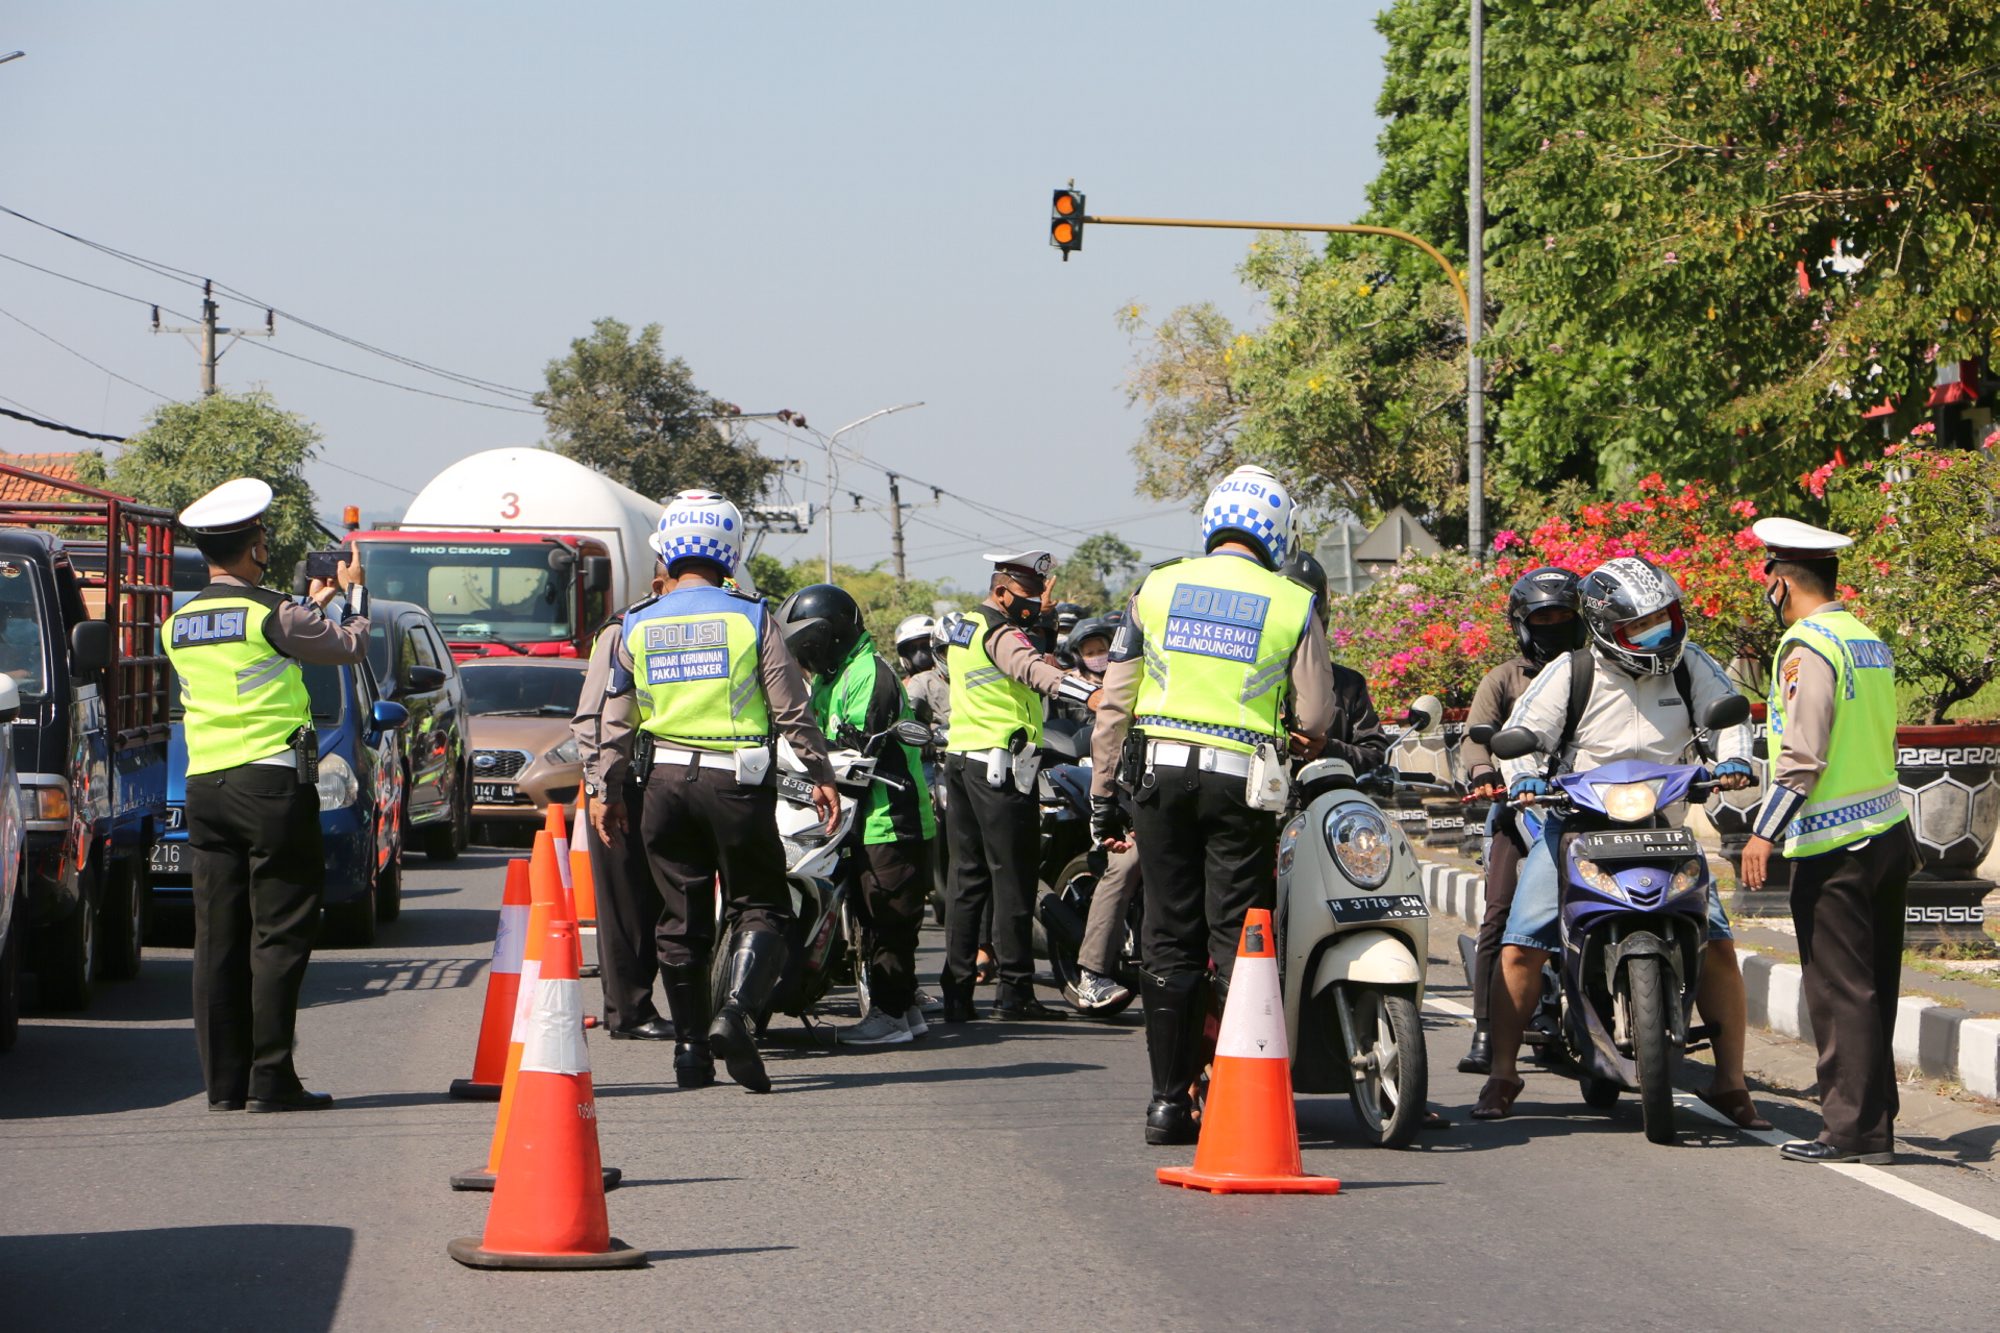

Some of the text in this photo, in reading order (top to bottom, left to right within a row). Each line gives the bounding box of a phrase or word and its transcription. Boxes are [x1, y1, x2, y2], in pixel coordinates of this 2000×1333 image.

[500, 492, 520, 520] 3
[669, 511, 720, 527] POLISI
[448, 547, 511, 556] CEMACO
[1171, 587, 1266, 624] POLISI
[173, 611, 244, 643] POLISI
[647, 621, 726, 648] POLISI
[1168, 619, 1257, 645] MASKERMU
[1166, 633, 1254, 660] MELINDUNGIKU
[649, 650, 723, 668] HINDARI KERUMUNAN
[652, 663, 722, 681] PAKAI MASKER
[501, 785, 514, 797] GA
[782, 778, 814, 794] 6386
[1594, 836, 1604, 846] H
[1665, 832, 1684, 843] IP
[1331, 900, 1343, 911] H
[1350, 897, 1390, 910] 3778
